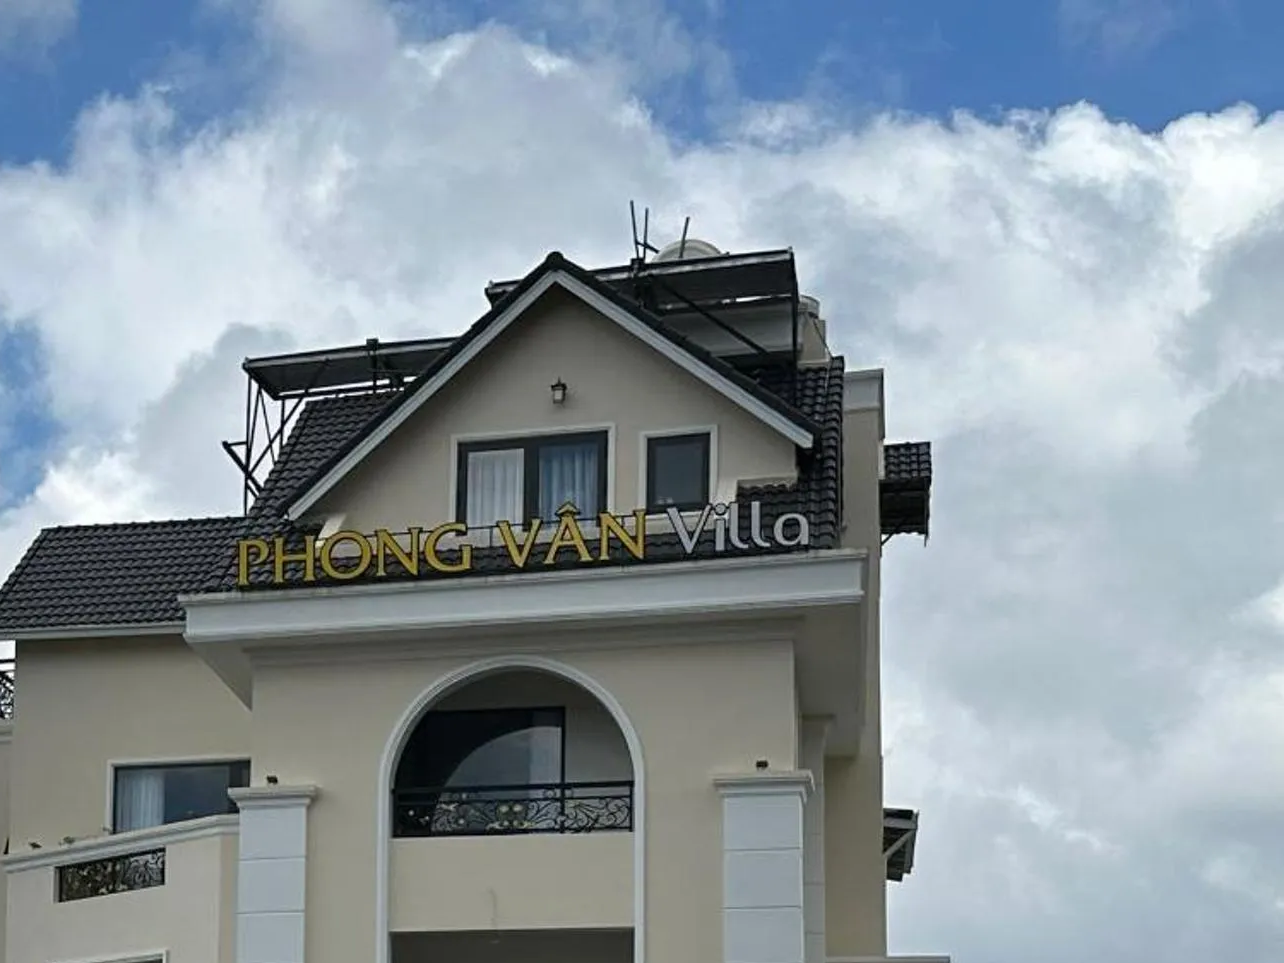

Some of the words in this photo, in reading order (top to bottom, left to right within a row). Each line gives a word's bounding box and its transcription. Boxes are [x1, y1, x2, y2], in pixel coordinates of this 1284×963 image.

[237, 522, 473, 586] PHONG
[497, 500, 647, 569] VÂN
[667, 500, 812, 556] Villa
